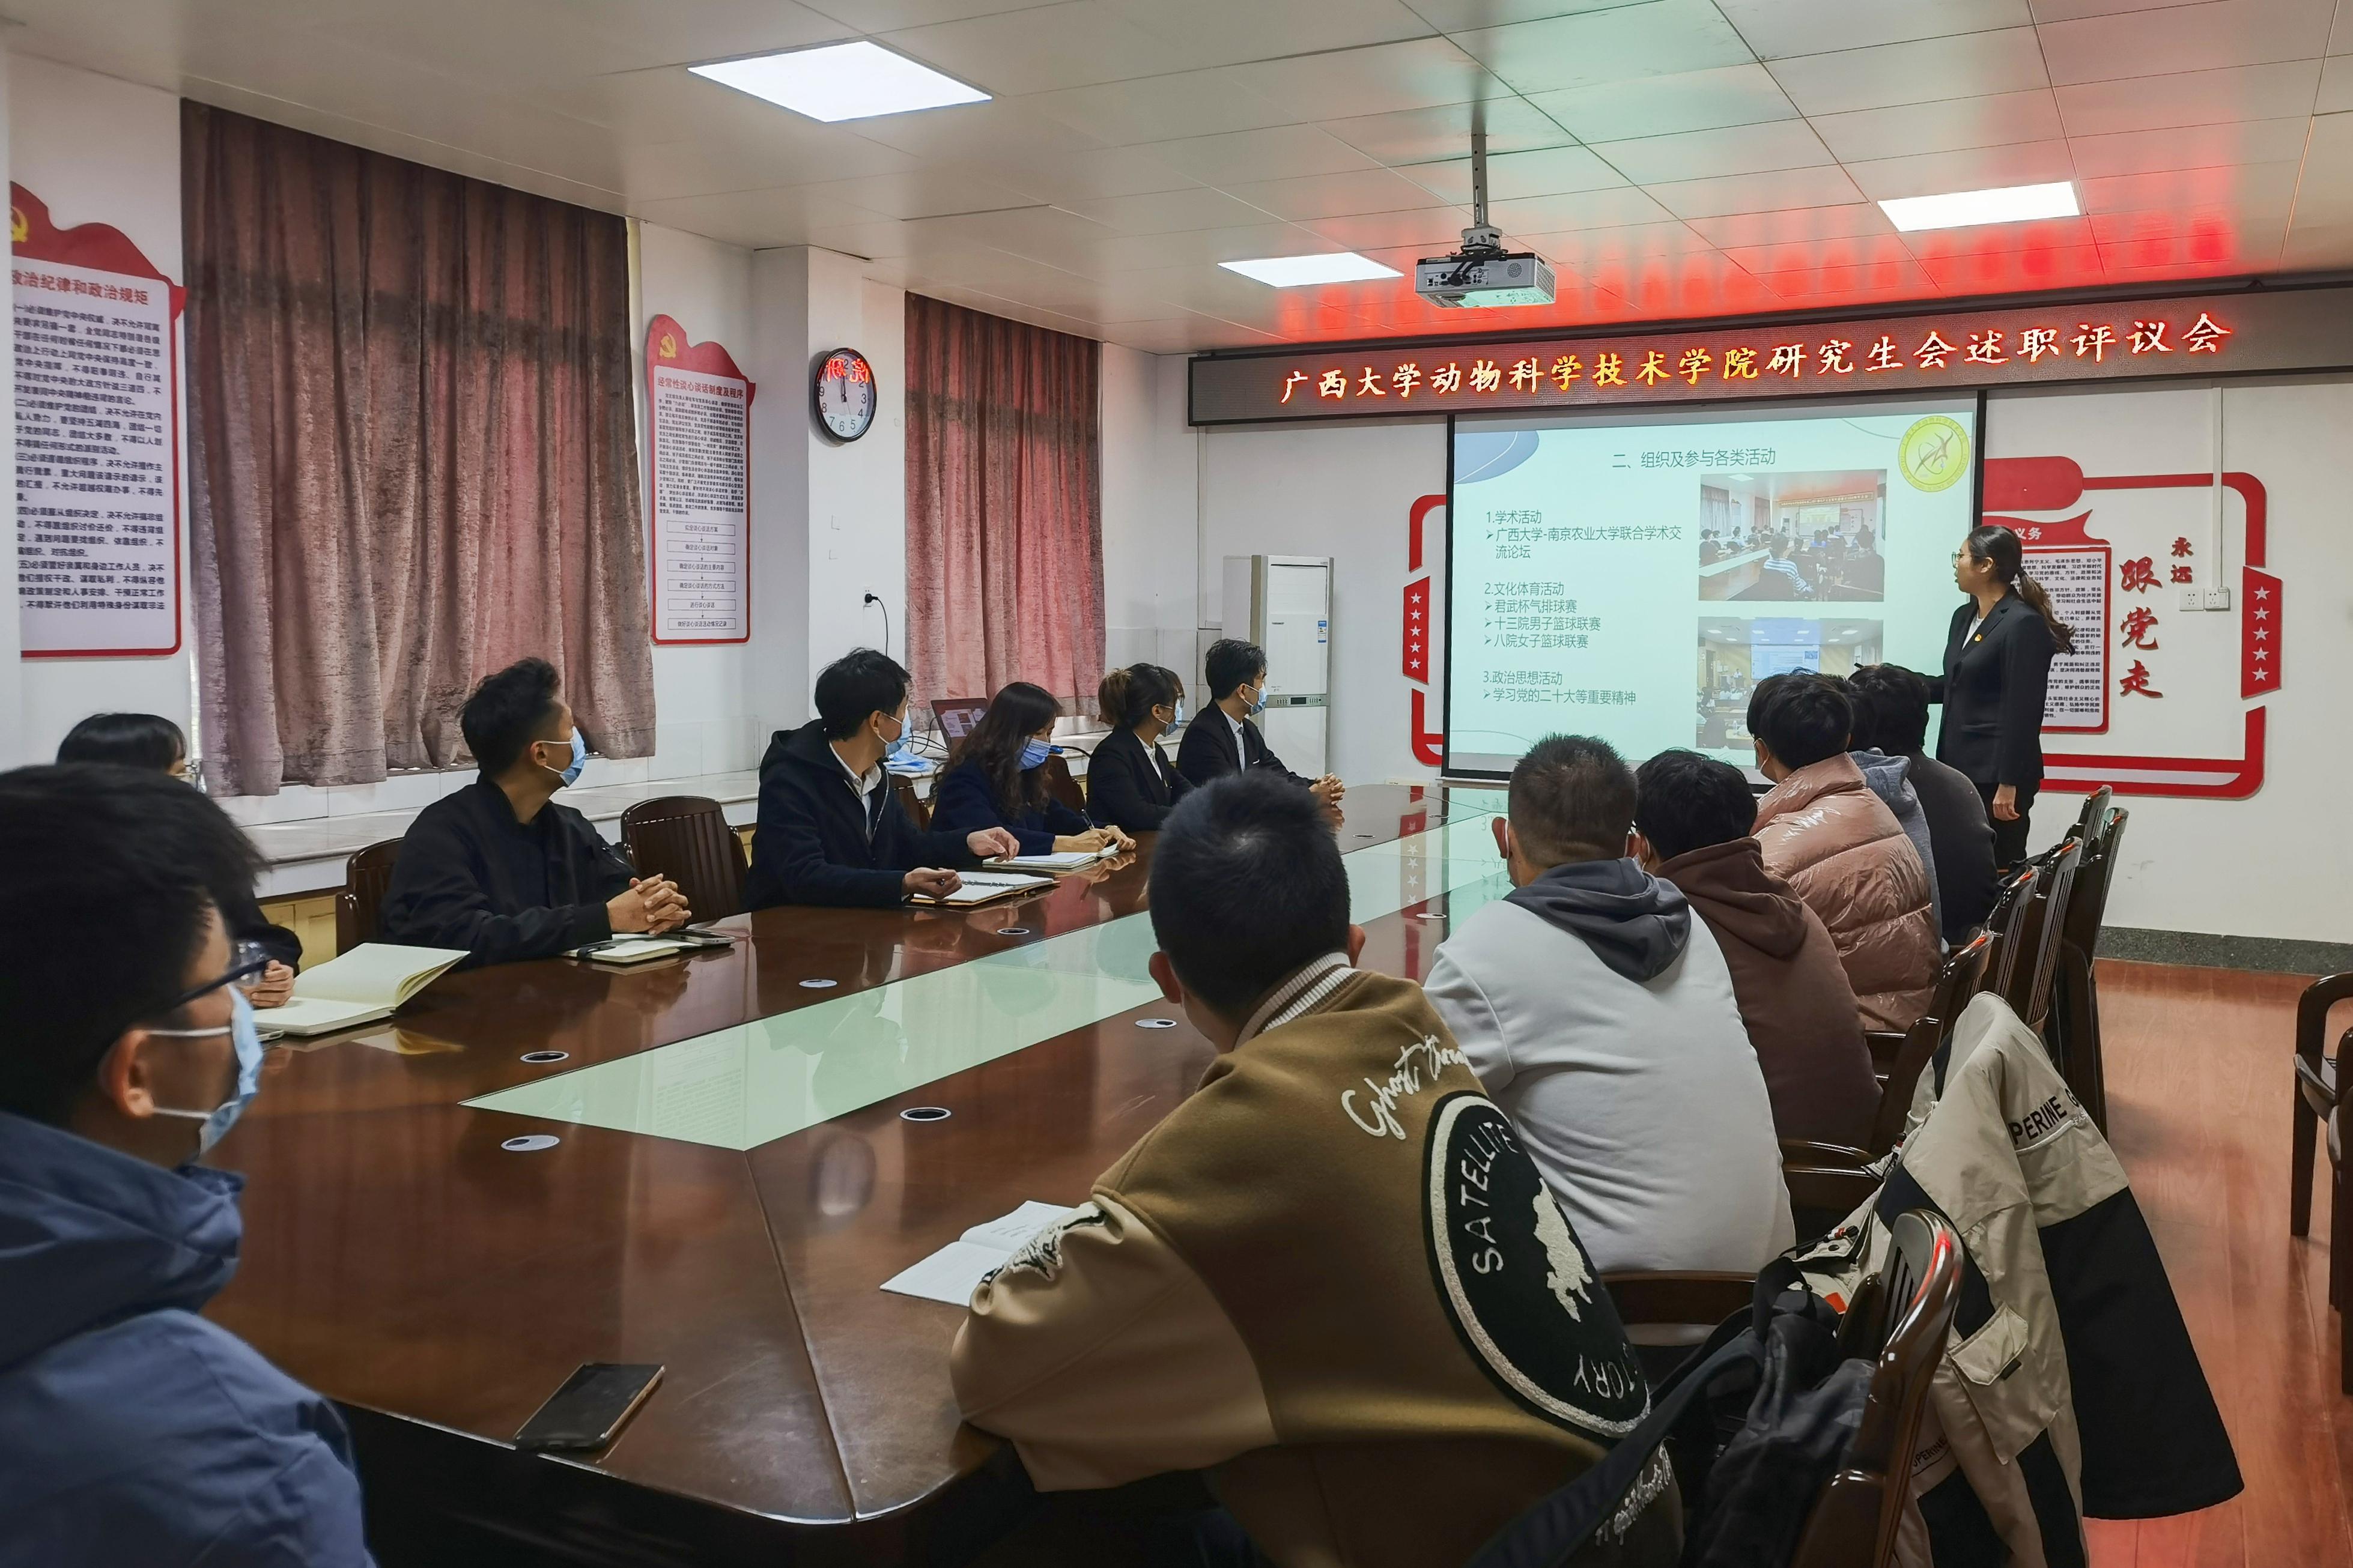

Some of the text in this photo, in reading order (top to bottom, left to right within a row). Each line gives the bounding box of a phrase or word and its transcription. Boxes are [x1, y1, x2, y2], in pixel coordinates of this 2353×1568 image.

[1280, 312, 2232, 404] 广西大学动物科学技术学院研究生会述职评议会
[657, 376, 744, 399] 经常性谈心谈话制度及程序
[1612, 448, 1776, 468] 二、组织及参与各类活动
[1486, 510, 1542, 525] 1.学术活动
[1496, 525, 1682, 542] 广西大学-南京农业大学联合学术交
[1496, 545, 1531, 560] 流论坛
[2170, 536, 2194, 584] 永远
[1484, 582, 1565, 596] 2.文化体育活动
[1495, 599, 1577, 614] 君武杯气排球赛
[1495, 616, 1601, 631] 十三院男子篮球联赛
[2119, 556, 2163, 700] 跟党走
[1494, 634, 1589, 649] 八院女子篮球联赛
[1483, 671, 1562, 686] 3.政治思想活动
[1493, 688, 1636, 706] 学习党的二十大等重要精神
[1460, 1121, 1520, 1275] SATELLITE
